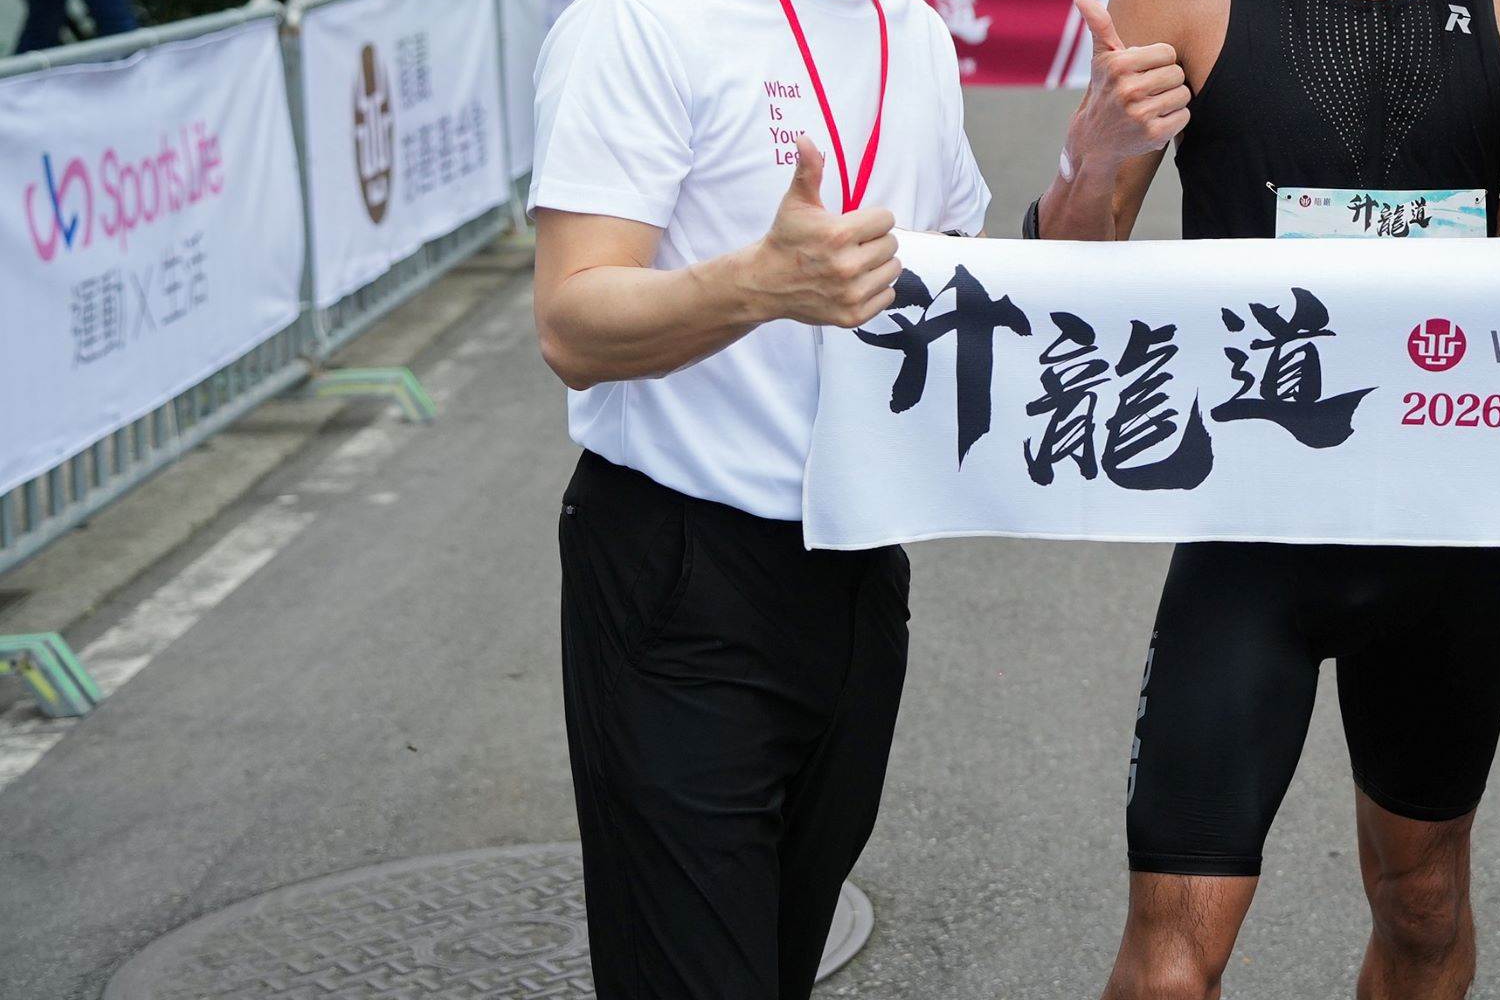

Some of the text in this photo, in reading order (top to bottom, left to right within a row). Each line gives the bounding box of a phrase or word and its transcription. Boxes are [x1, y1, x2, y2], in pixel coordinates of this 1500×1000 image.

[764, 80, 801, 98] What
[770, 103, 783, 120] Is
[1347, 193, 1434, 237] 升龍道
[854, 262, 1381, 490] 升龍道
